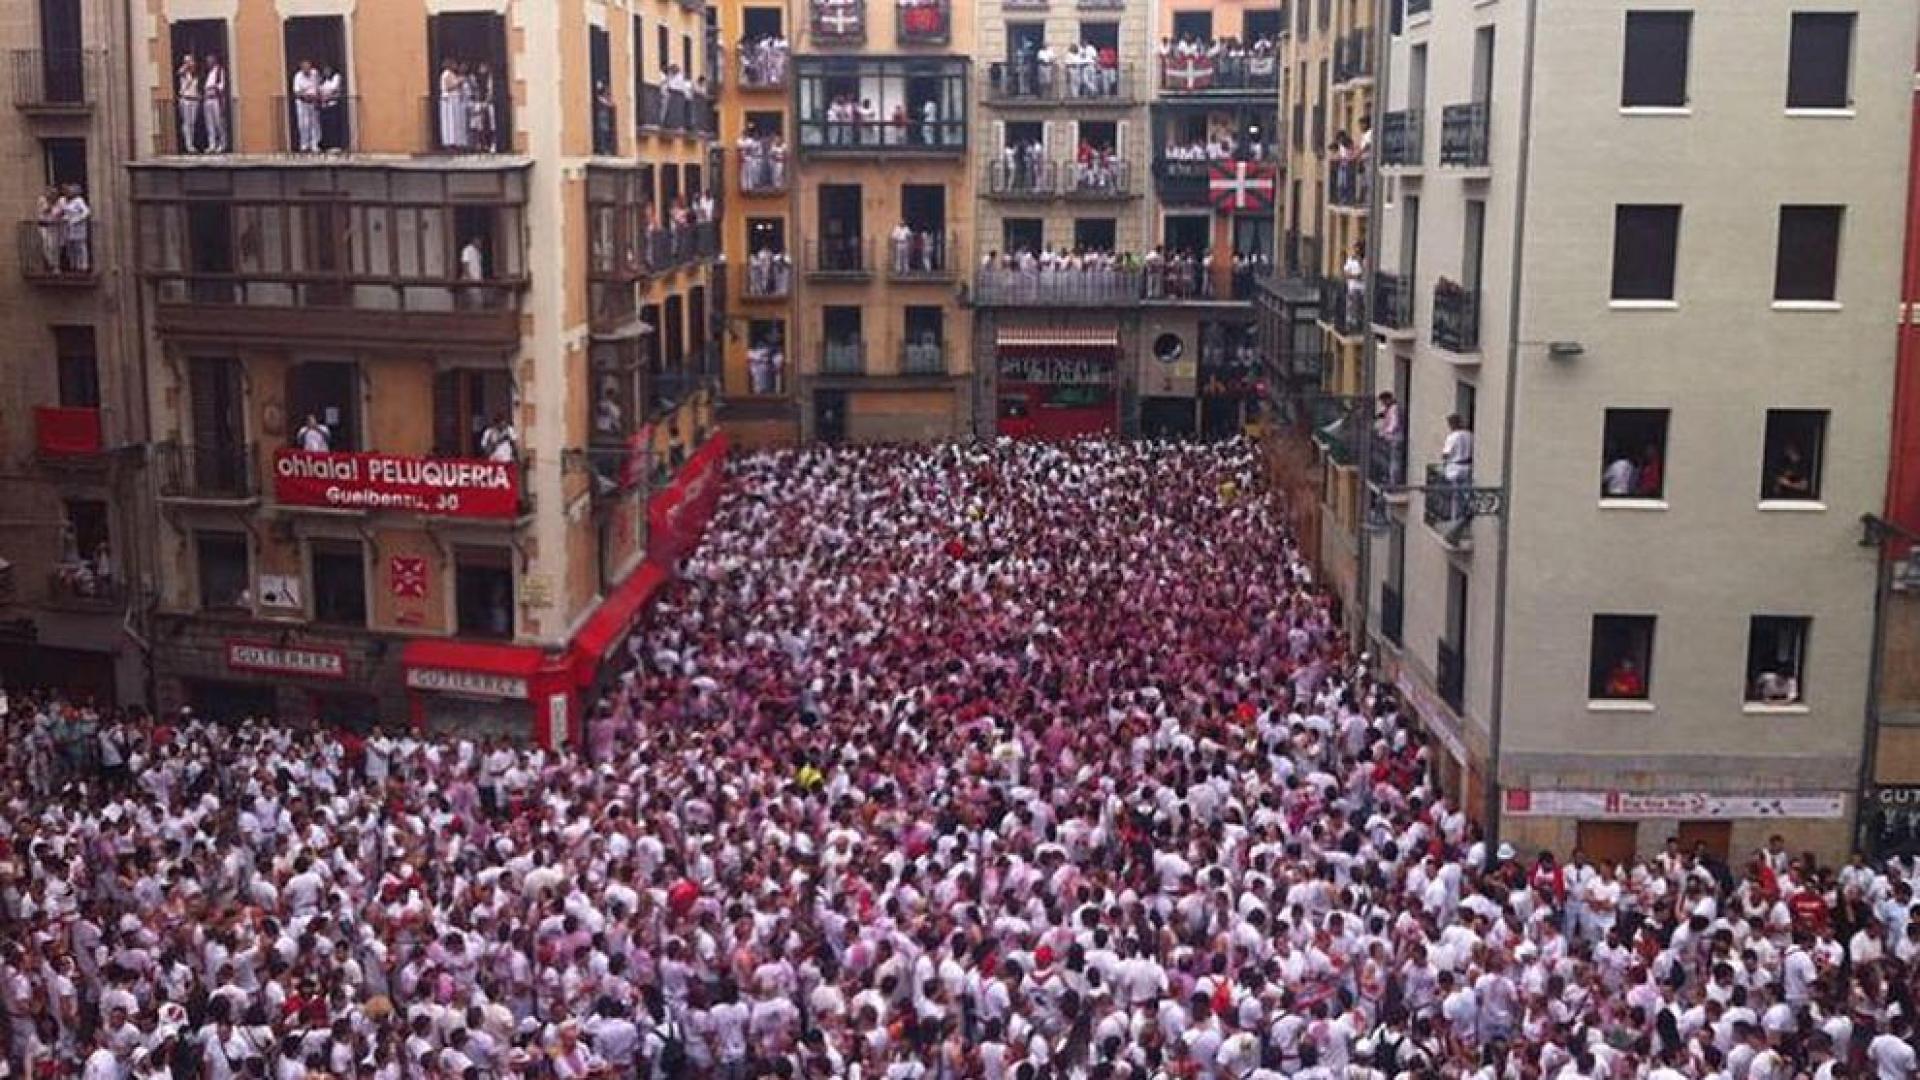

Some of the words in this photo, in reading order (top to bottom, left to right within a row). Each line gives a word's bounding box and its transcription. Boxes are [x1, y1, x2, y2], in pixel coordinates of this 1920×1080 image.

[278, 455, 358, 480] ohlala!
[237, 647, 336, 670] GUTIERREZ
[416, 670, 519, 695] GUTIERREZ
